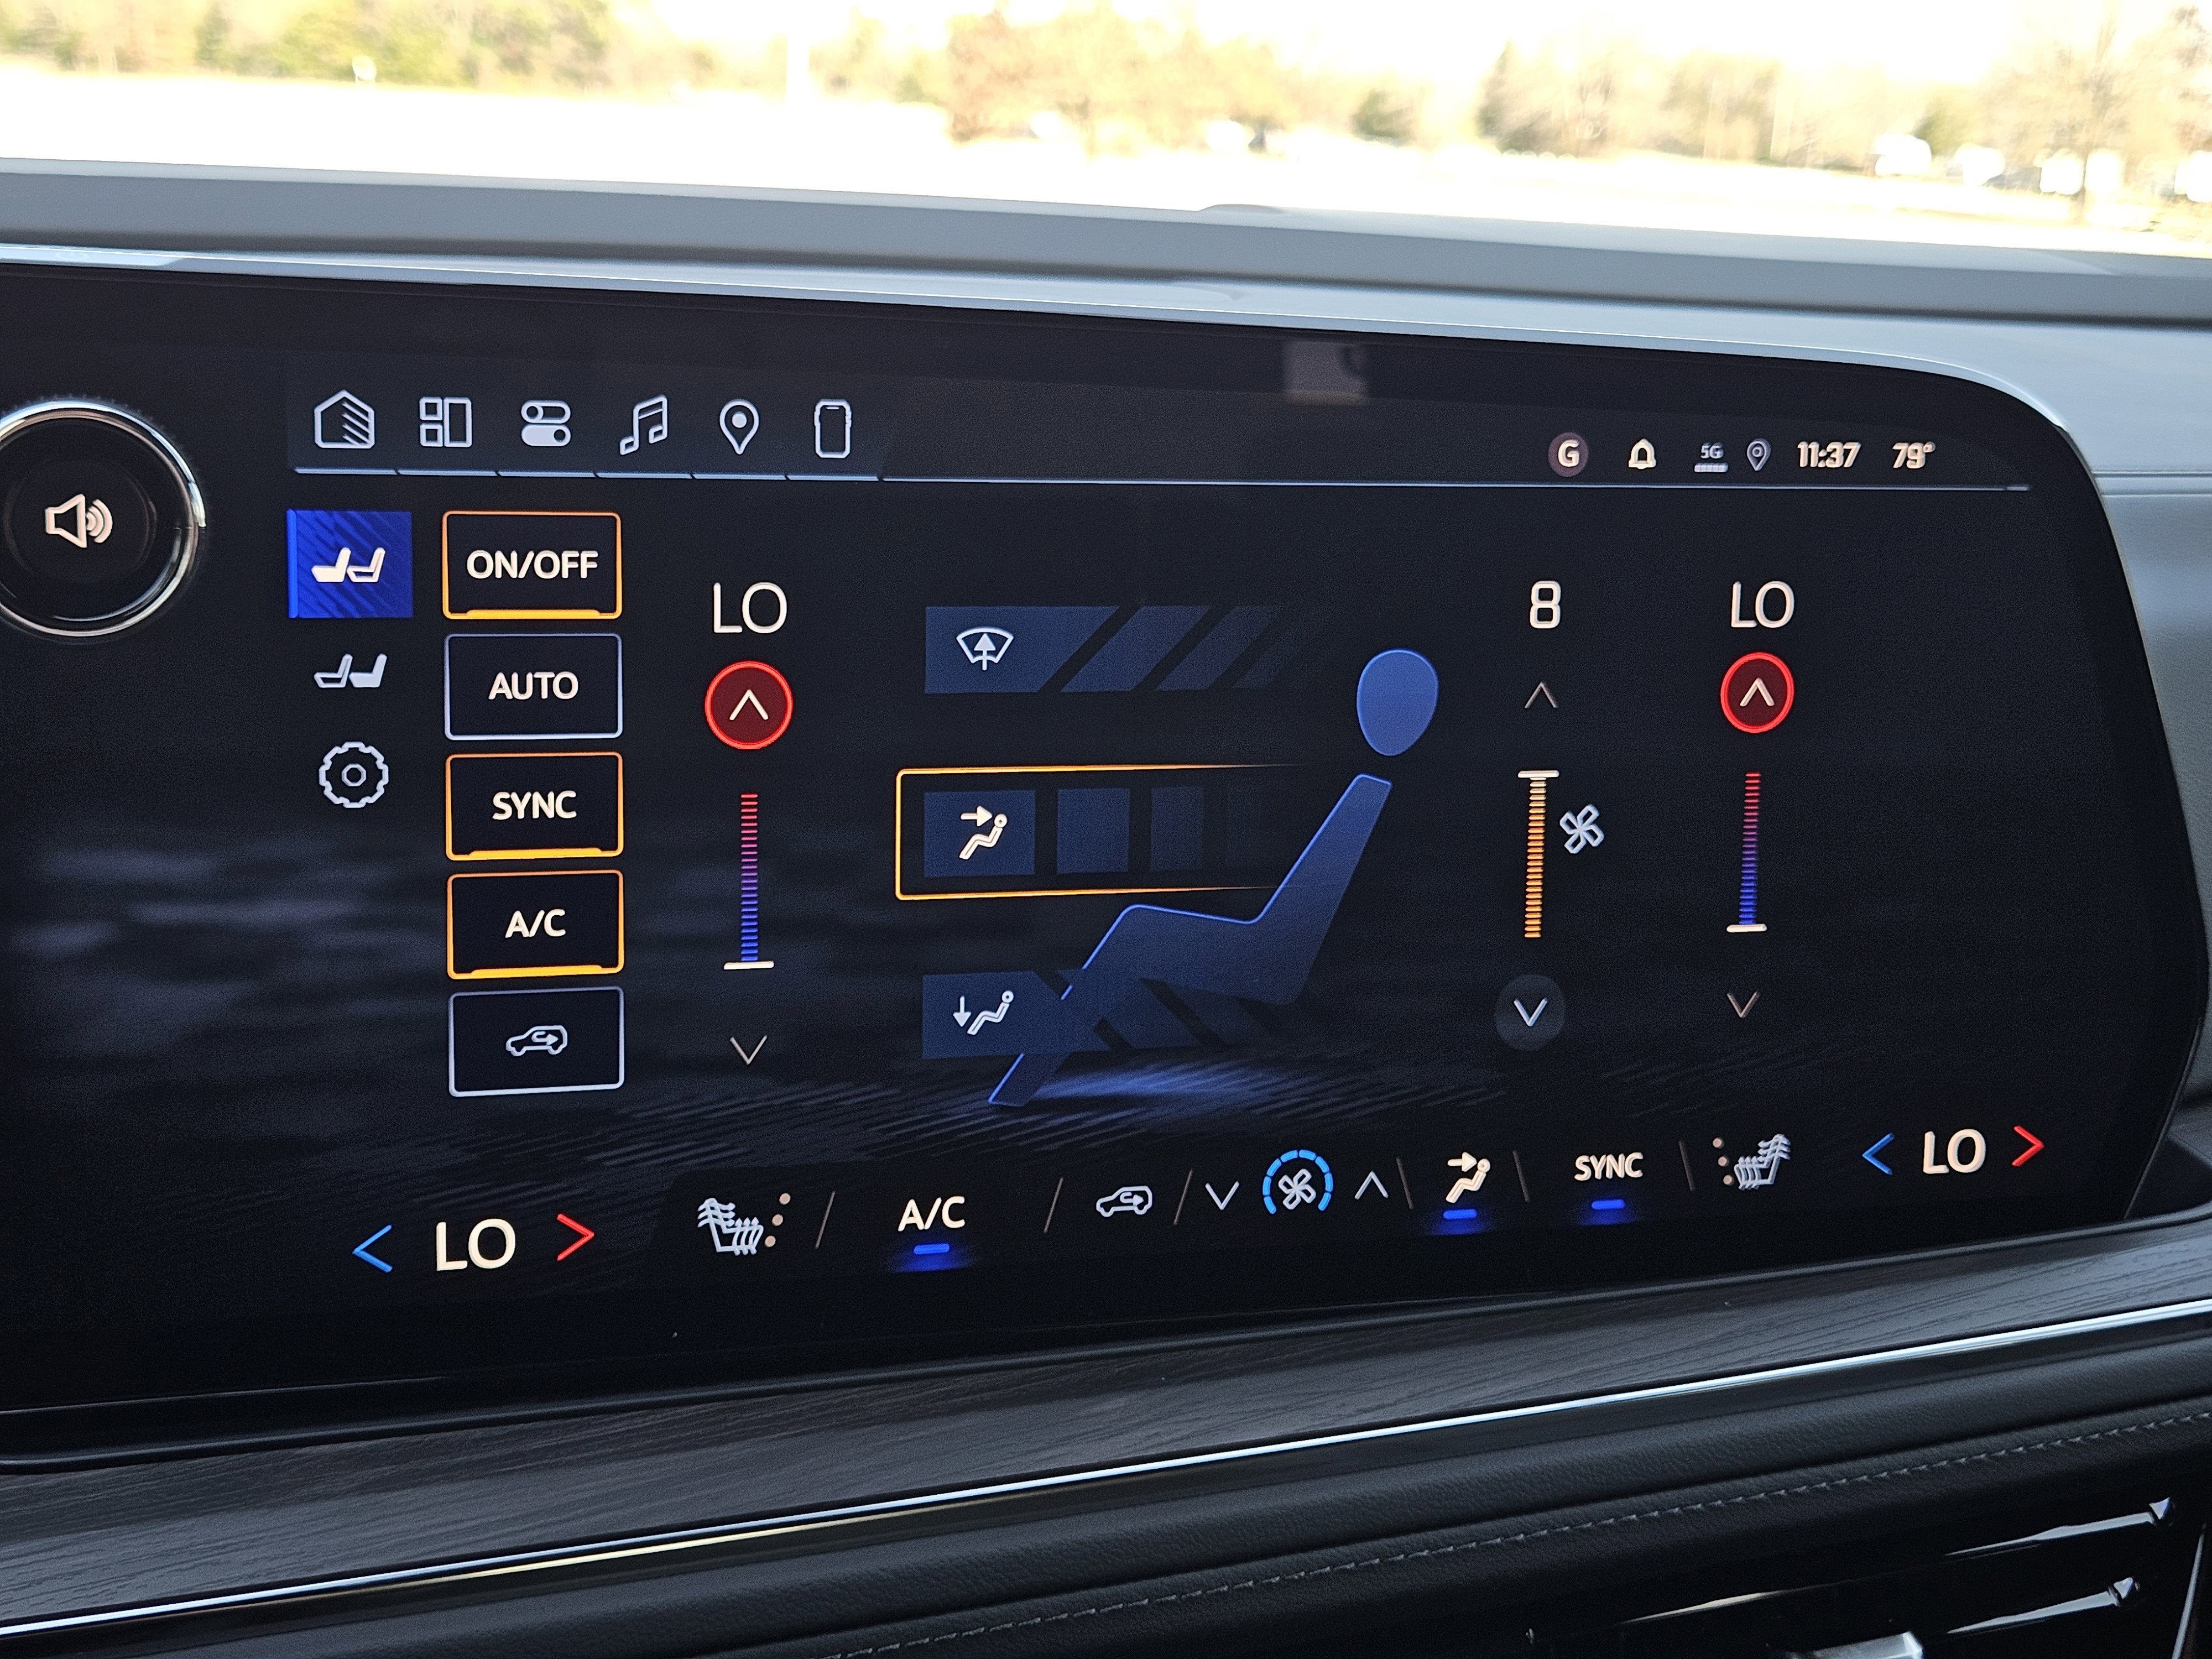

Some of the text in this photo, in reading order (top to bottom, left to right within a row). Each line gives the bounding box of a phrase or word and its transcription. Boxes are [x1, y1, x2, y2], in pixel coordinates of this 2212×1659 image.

[1558, 439, 1580, 467] G
[1700, 443, 1723, 459] 5G
[1797, 441, 1861, 468] 11:37
[1892, 441, 1936, 469] 79°
[466, 550, 598, 579] ON/OFF
[713, 582, 787, 634] LO
[1530, 580, 1561, 629] 8
[1731, 581, 1794, 628] LO
[488, 671, 578, 700] AUTO
[492, 790, 577, 820] SYNC
[505, 909, 566, 938] A/C
[1923, 1129, 1986, 1174] LO
[1574, 1152, 1644, 1181] SYNC
[898, 1196, 966, 1232] A/C
[436, 1218, 516, 1271] LO
